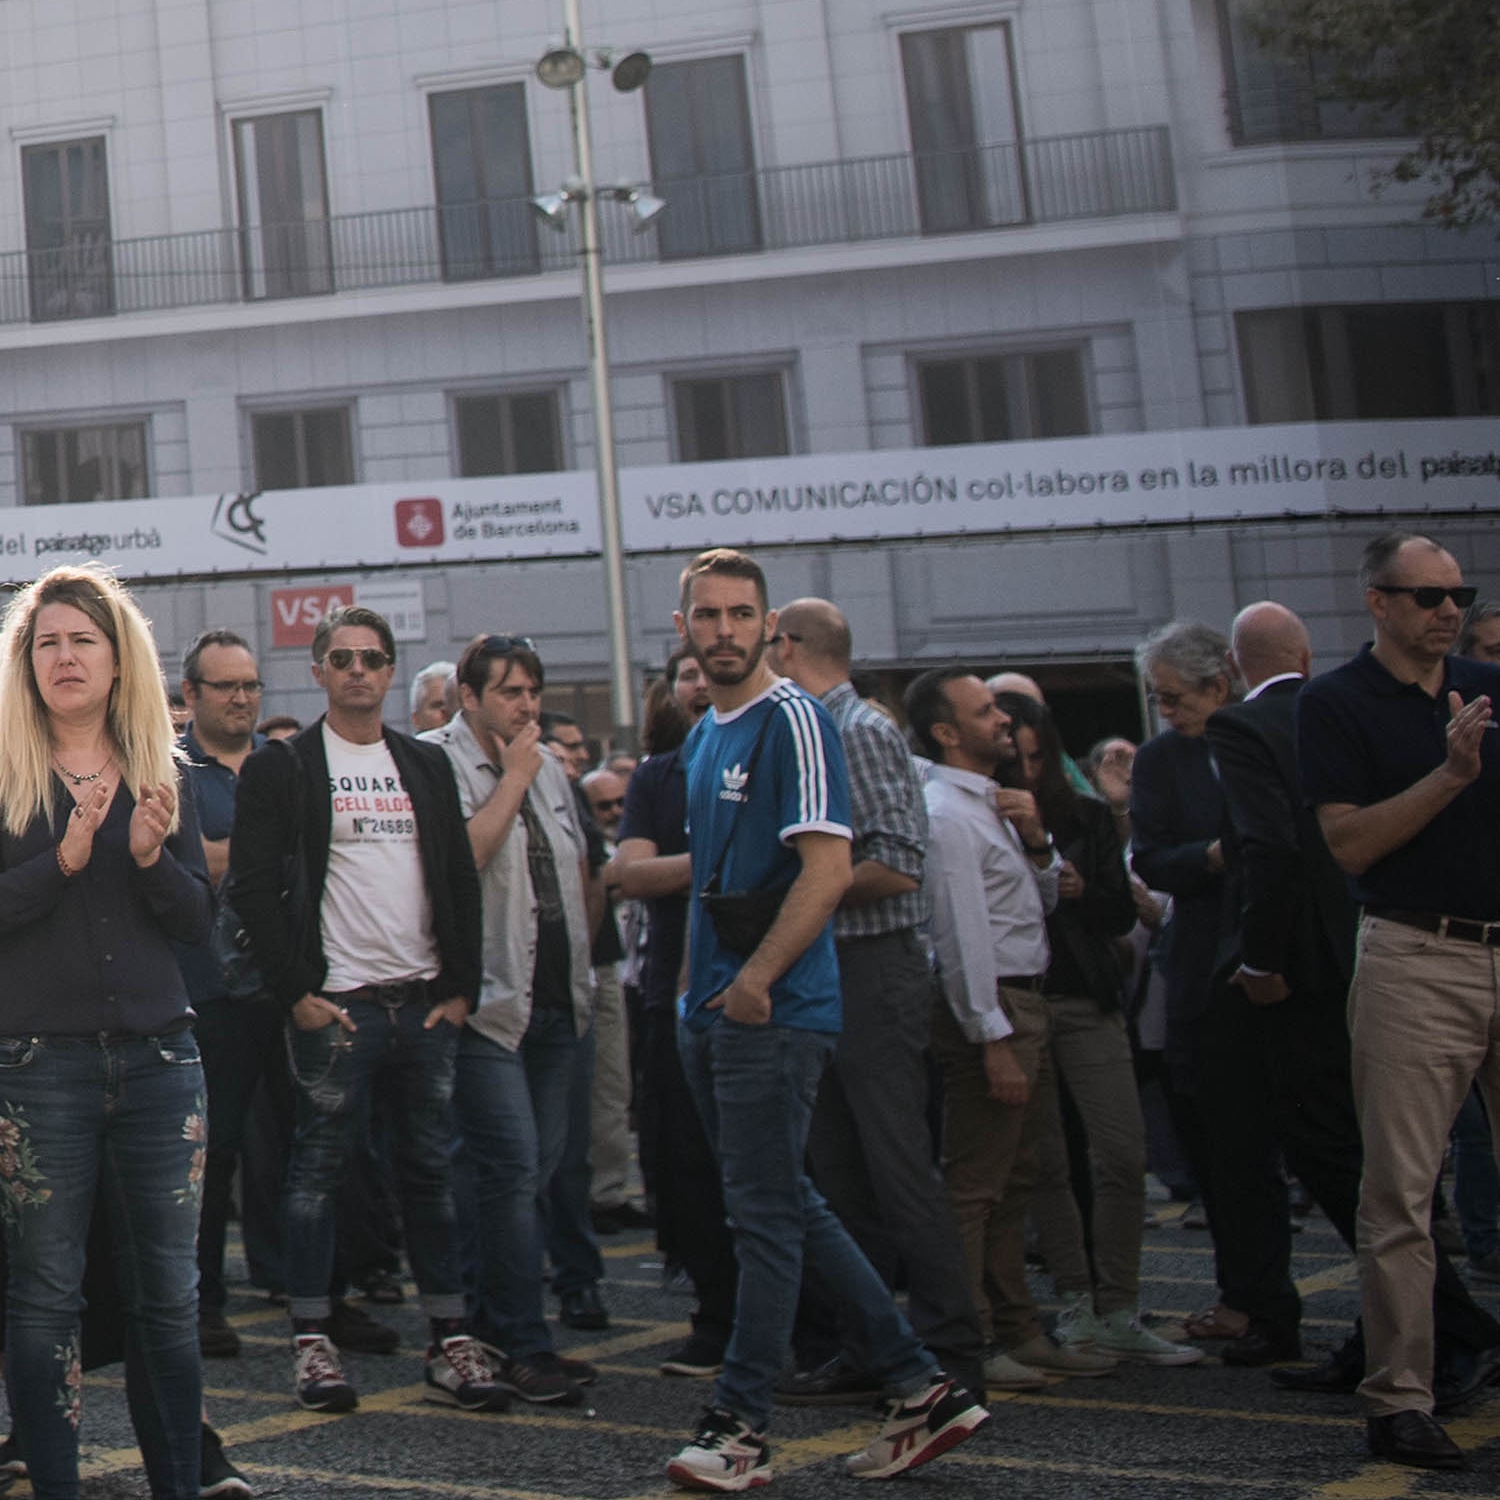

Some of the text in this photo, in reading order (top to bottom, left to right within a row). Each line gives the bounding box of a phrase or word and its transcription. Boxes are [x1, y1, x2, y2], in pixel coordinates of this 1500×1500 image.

[645, 491, 705, 518] VSA
[711, 471, 957, 516] COMUNICACIÓN
[1140, 464, 1179, 490] en
[1187, 459, 1218, 488] la
[1230, 453, 1348, 486] millora
[1358, 451, 1409, 480] del
[452, 497, 562, 520] Ajuntament
[112, 526, 163, 551] urbà
[454, 515, 580, 540] de Barcelona
[329, 777, 407, 793] SQUAR
[334, 797, 371, 813] CELL
